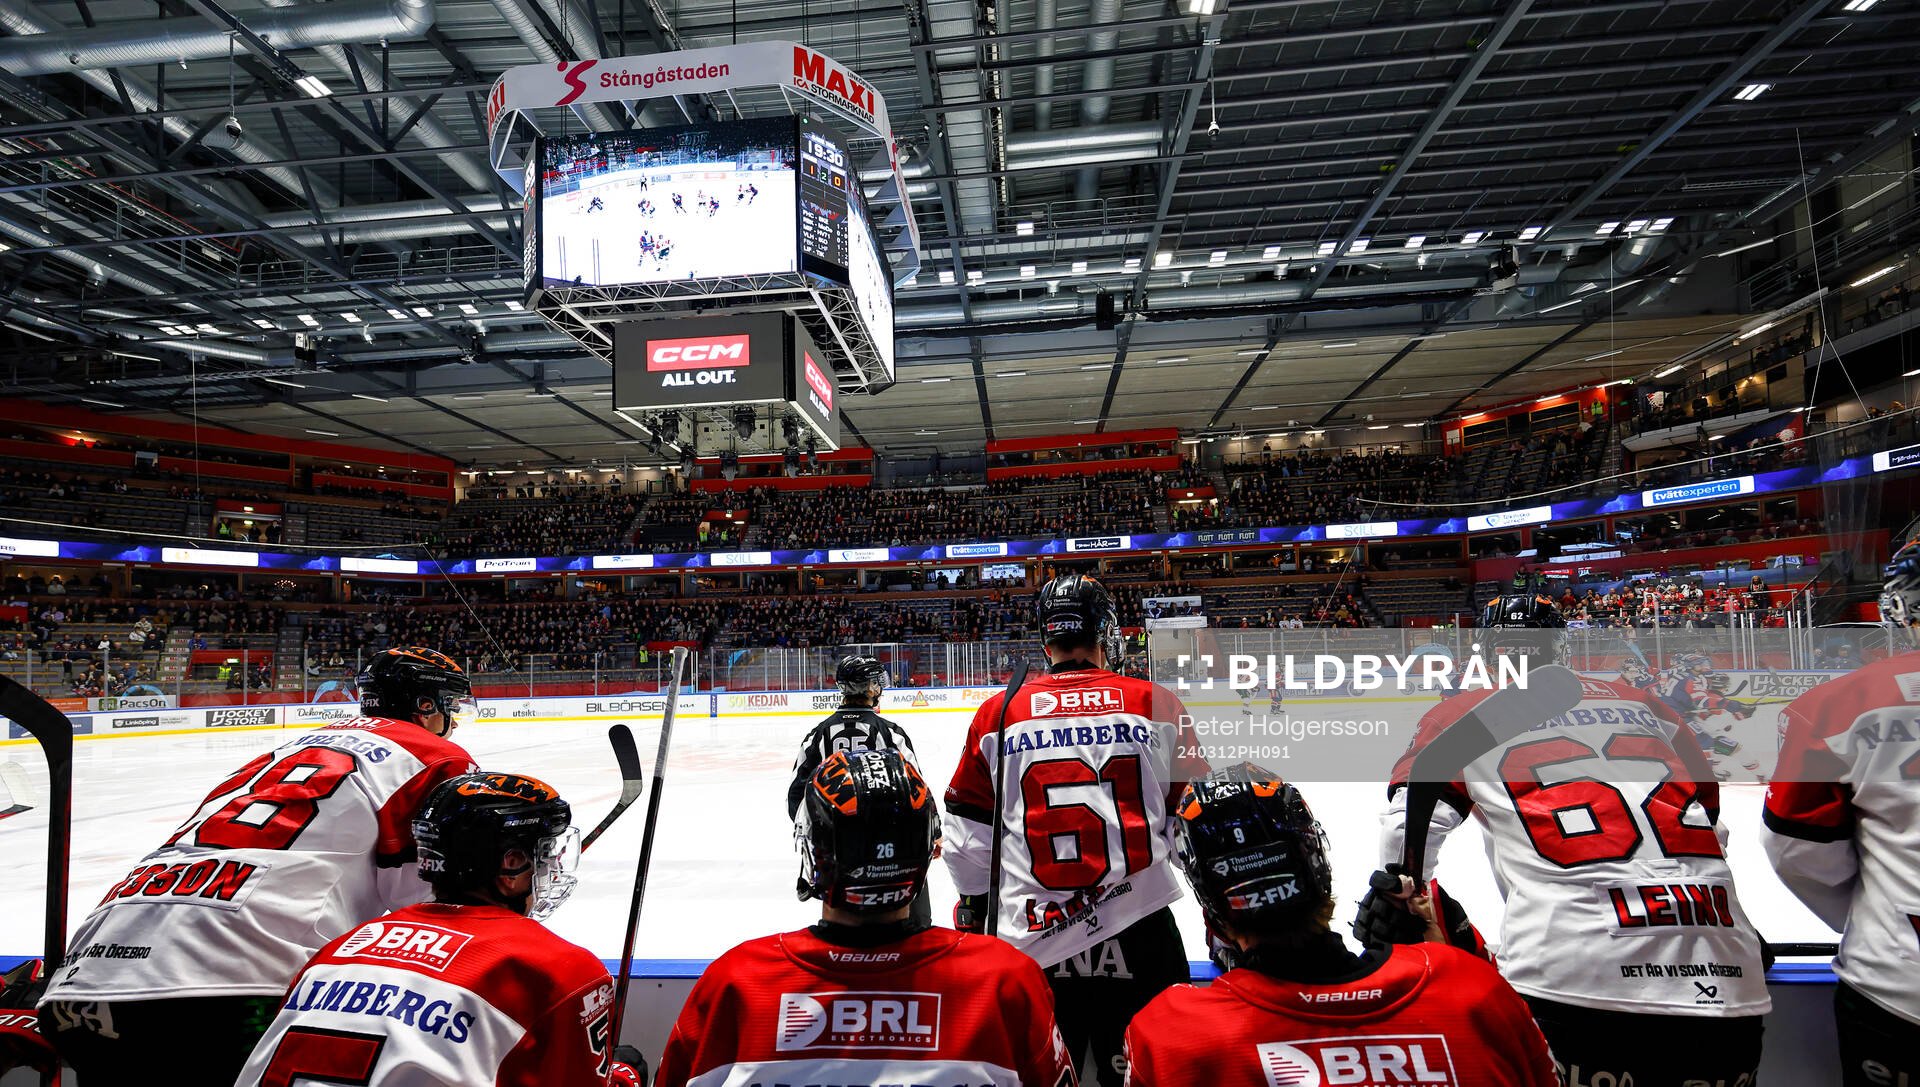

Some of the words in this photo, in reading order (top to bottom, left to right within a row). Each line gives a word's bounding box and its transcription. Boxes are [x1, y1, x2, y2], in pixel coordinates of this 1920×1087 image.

[600, 63, 729, 89] Stångåstaden
[794, 46, 874, 116] MAXI
[794, 77, 809, 90] ICA
[811, 84, 874, 124] STORMARKNAD
[808, 140, 843, 167] 19:30
[653, 343, 744, 363] CCM
[662, 372, 694, 387] ALL
[696, 370, 736, 385] OUT.
[806, 363, 832, 402] CCM
[1654, 482, 1737, 501] tvättexperten
[1344, 525, 1377, 536] SKILL
[1511, 612, 1523, 620] 62
[119, 698, 166, 709] PacsOn
[1061, 690, 1119, 707] BRL
[125, 718, 157, 727] Linköping
[212, 709, 269, 721] HOCKEY
[223, 716, 265, 726] STORE
[1497, 733, 1726, 869] 62
[1020, 754, 1153, 891] 61
[1233, 827, 1245, 844] 9
[876, 843, 894, 859] 26
[1229, 852, 1263, 866] Thermia
[867, 863, 899, 872] Thermia
[1231, 853, 1287, 873] Värmepumpar
[1247, 879, 1300, 909] Z-FIX
[1608, 884, 1735, 928] LEINO
[379, 926, 451, 957] BRL
[105, 943, 151, 959] ÖREBRO
[371, 947, 445, 966] ELECTRONICS
[840, 952, 900, 962] BAUER
[1620, 965, 1643, 977] DET
[1645, 963, 1664, 977] ÄR
[1664, 965, 1679, 977] VI
[1679, 965, 1708, 977] SOM
[1315, 988, 1382, 1003] BAUER
[831, 1000, 932, 1034] BRL
[831, 1035, 931, 1044] ELECTRONICS
[1320, 1044, 1448, 1085] BRL
